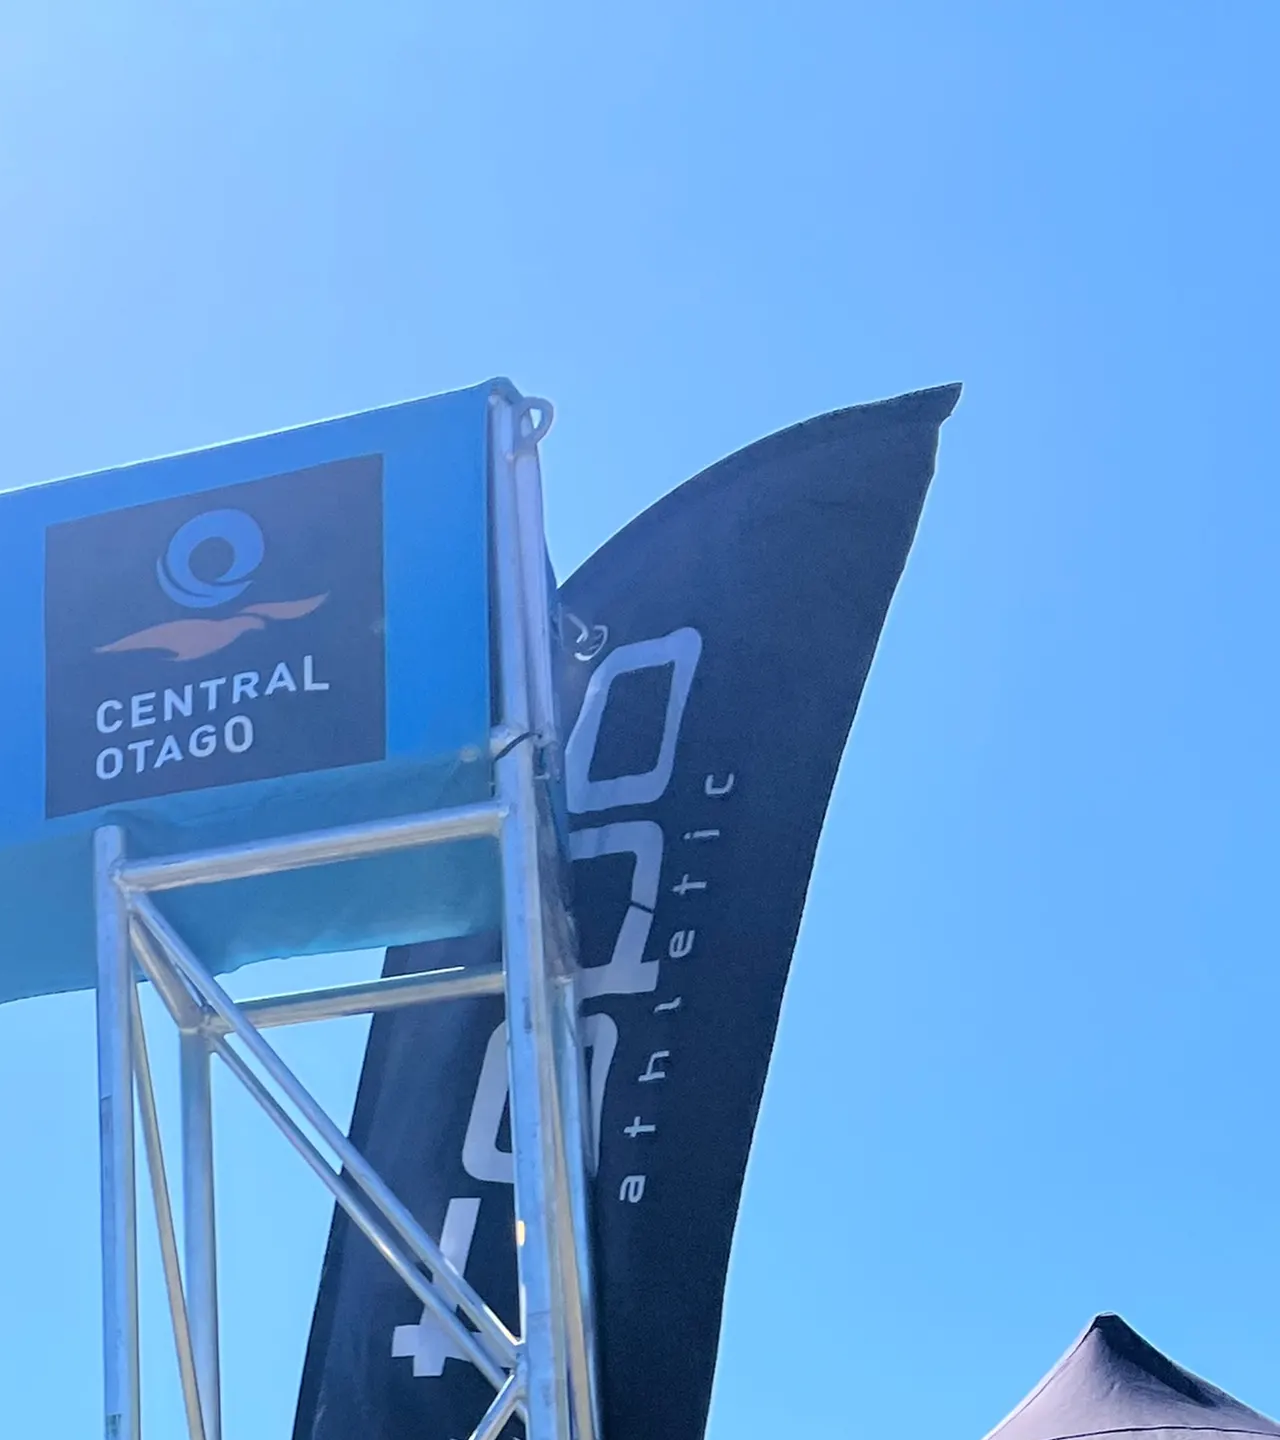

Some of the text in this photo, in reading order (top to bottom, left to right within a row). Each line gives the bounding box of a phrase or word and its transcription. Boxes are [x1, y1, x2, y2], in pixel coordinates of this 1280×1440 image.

[96, 654, 330, 734] CENTRAL
[95, 714, 254, 780] OTAGO
[620, 771, 735, 1204] athletic
